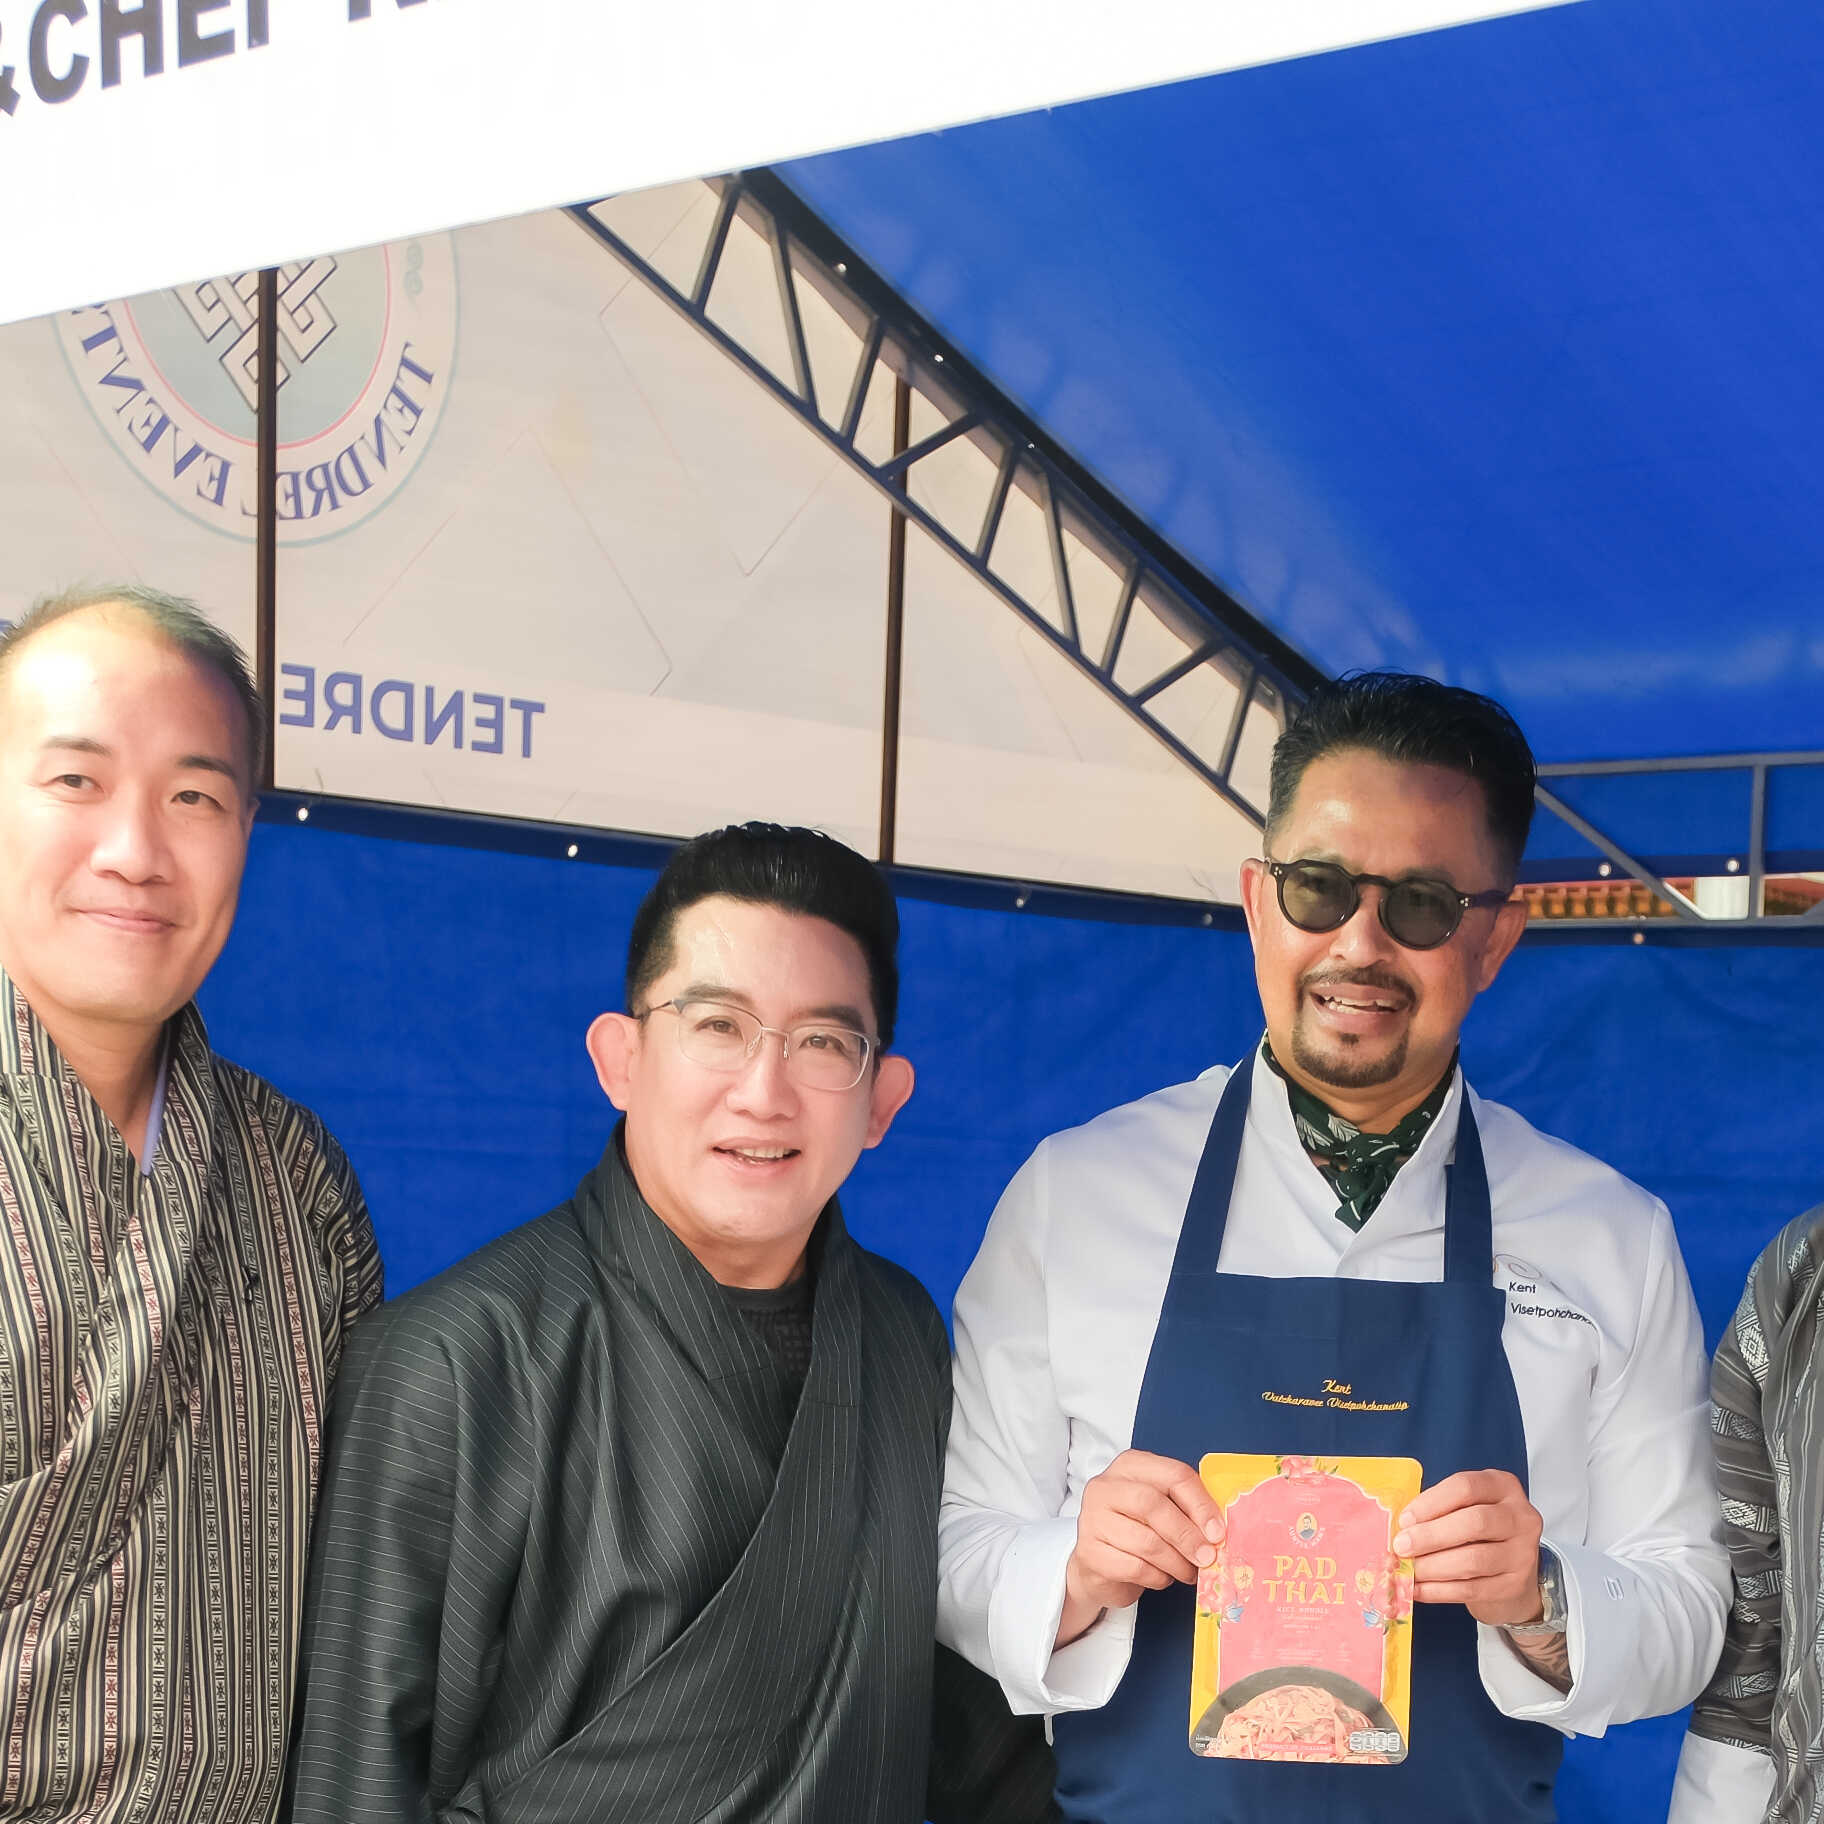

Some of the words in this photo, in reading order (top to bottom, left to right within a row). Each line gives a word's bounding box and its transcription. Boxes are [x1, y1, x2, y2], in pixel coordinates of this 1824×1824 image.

[1508, 1281, 1537, 1294] Kent
[1321, 1379, 1352, 1395] Kent
[1273, 1555, 1338, 1580] PAD
[1262, 1579, 1346, 1605] THAI
